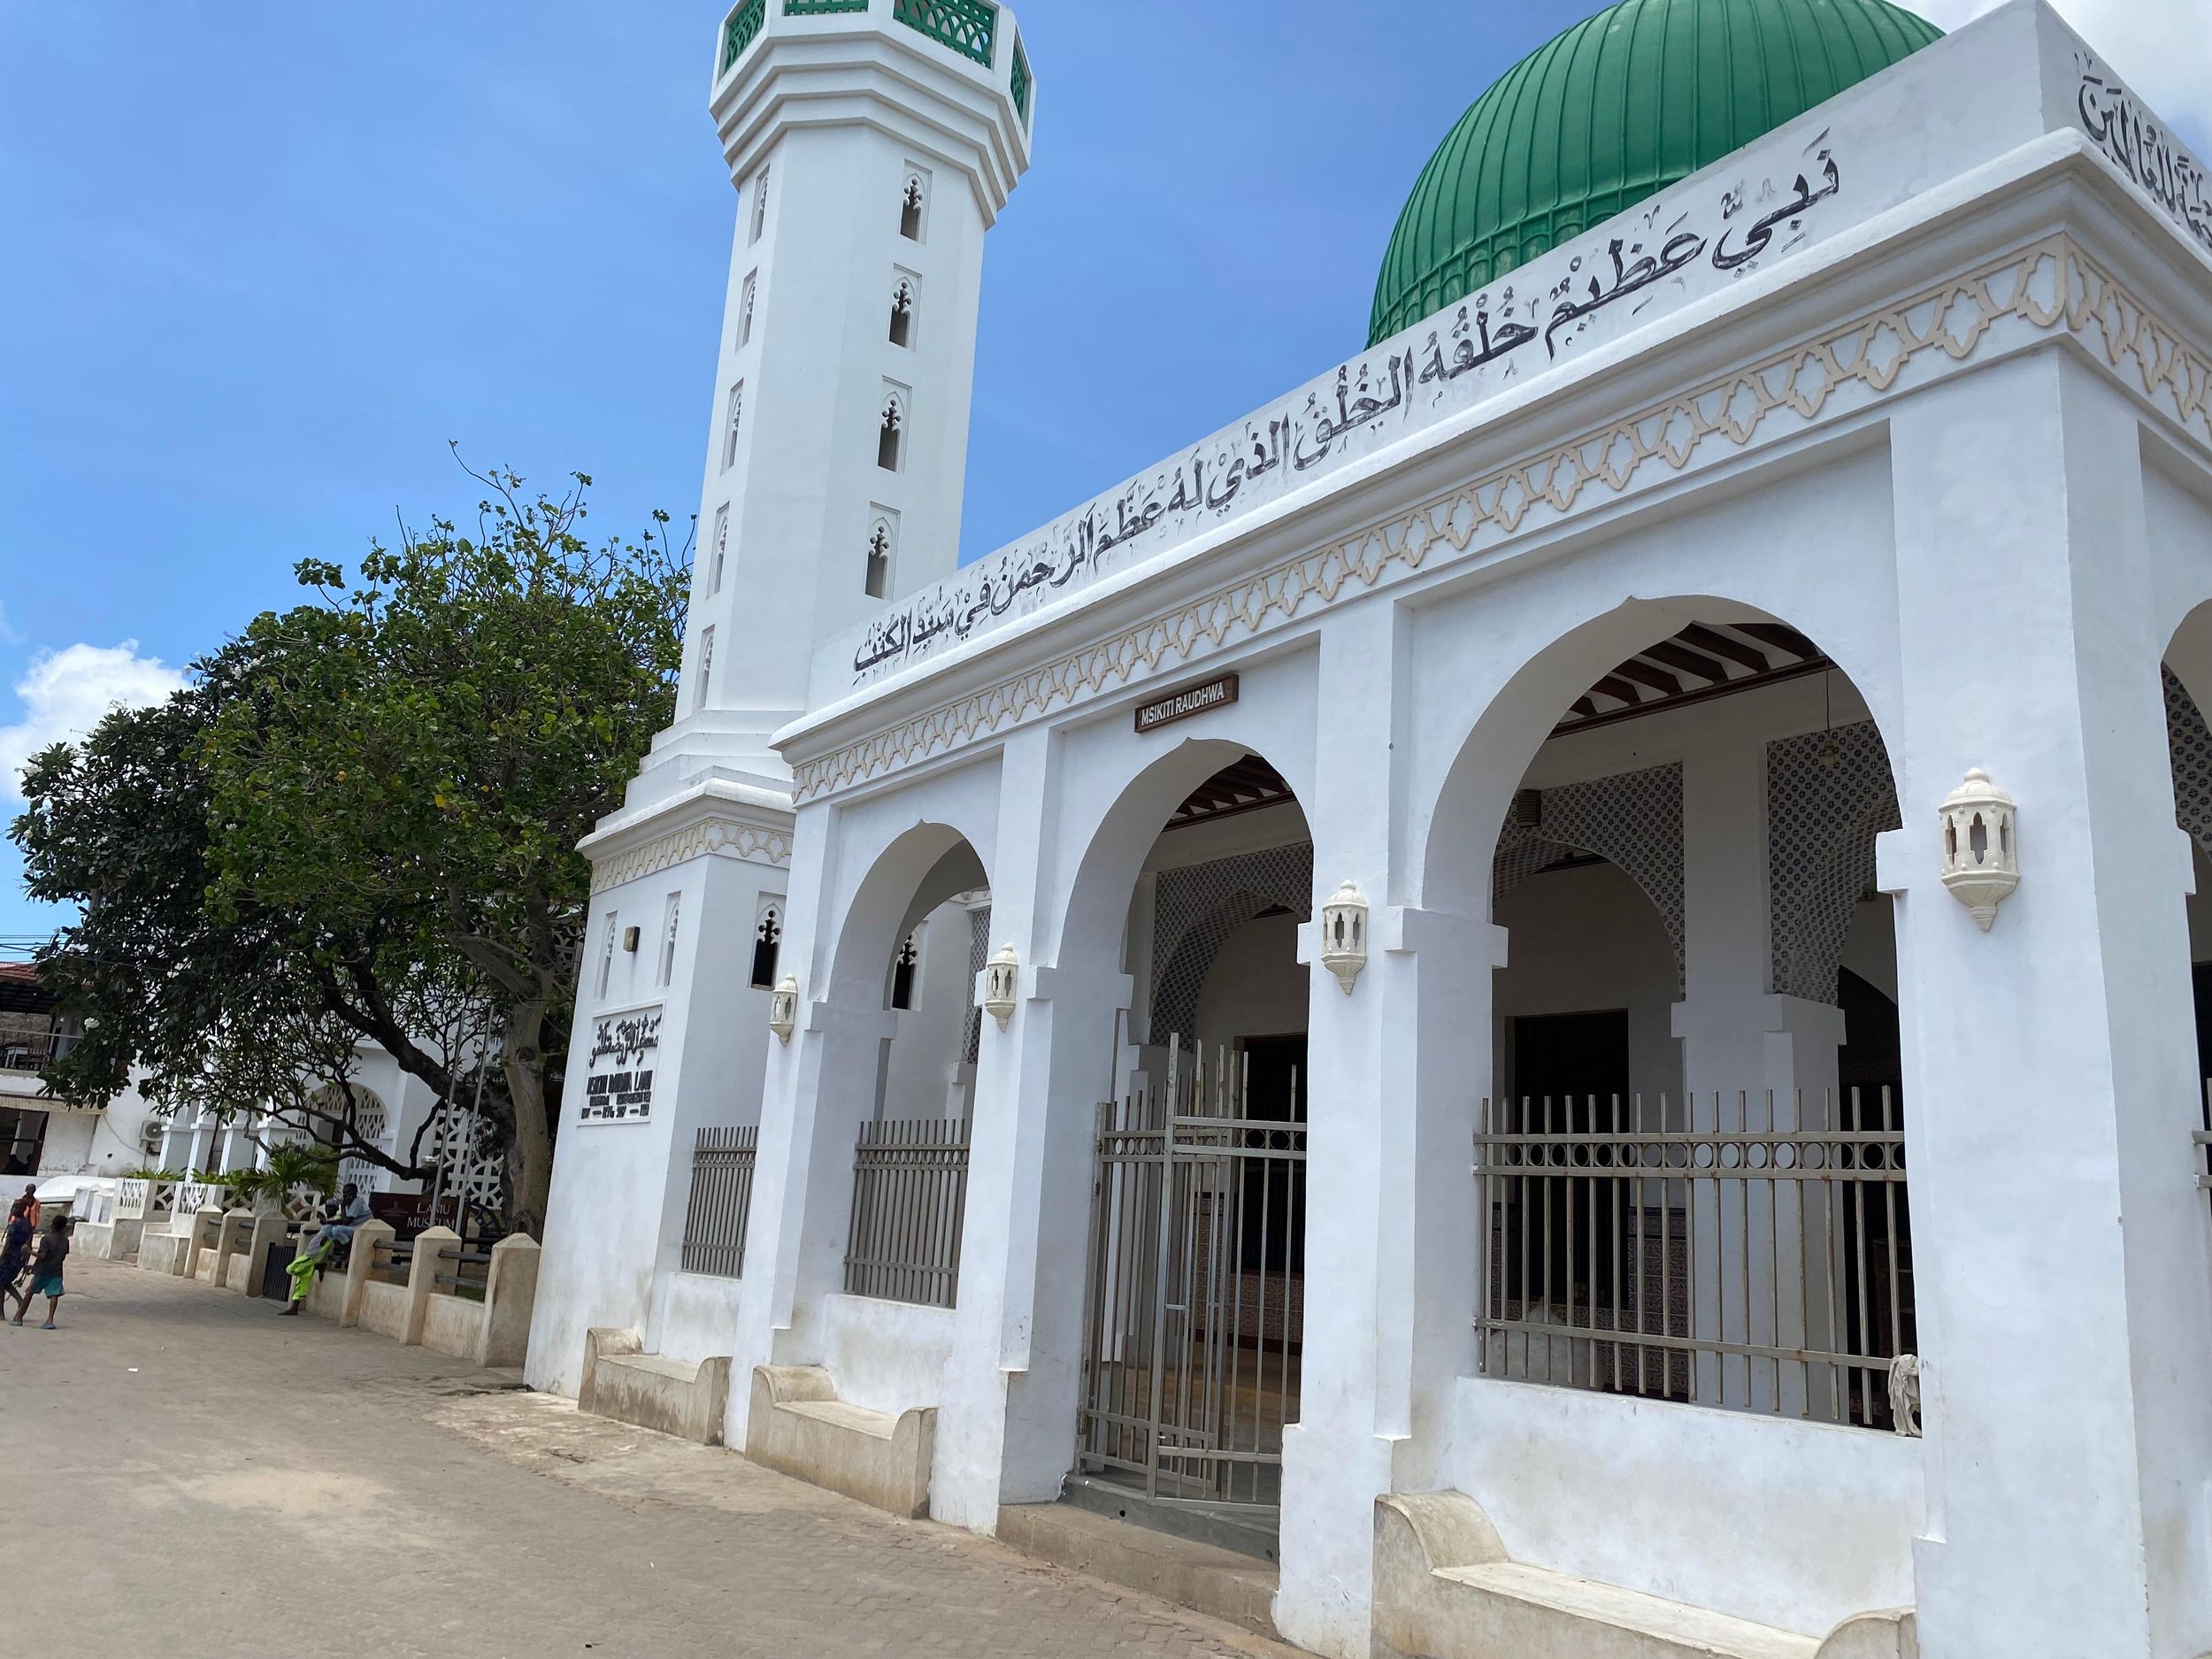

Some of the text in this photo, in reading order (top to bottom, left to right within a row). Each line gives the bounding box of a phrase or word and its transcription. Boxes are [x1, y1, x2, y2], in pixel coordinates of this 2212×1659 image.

[1141, 682, 1225, 726] MSIKITI RAUDHWA
[417, 1202, 451, 1215] LAMU
